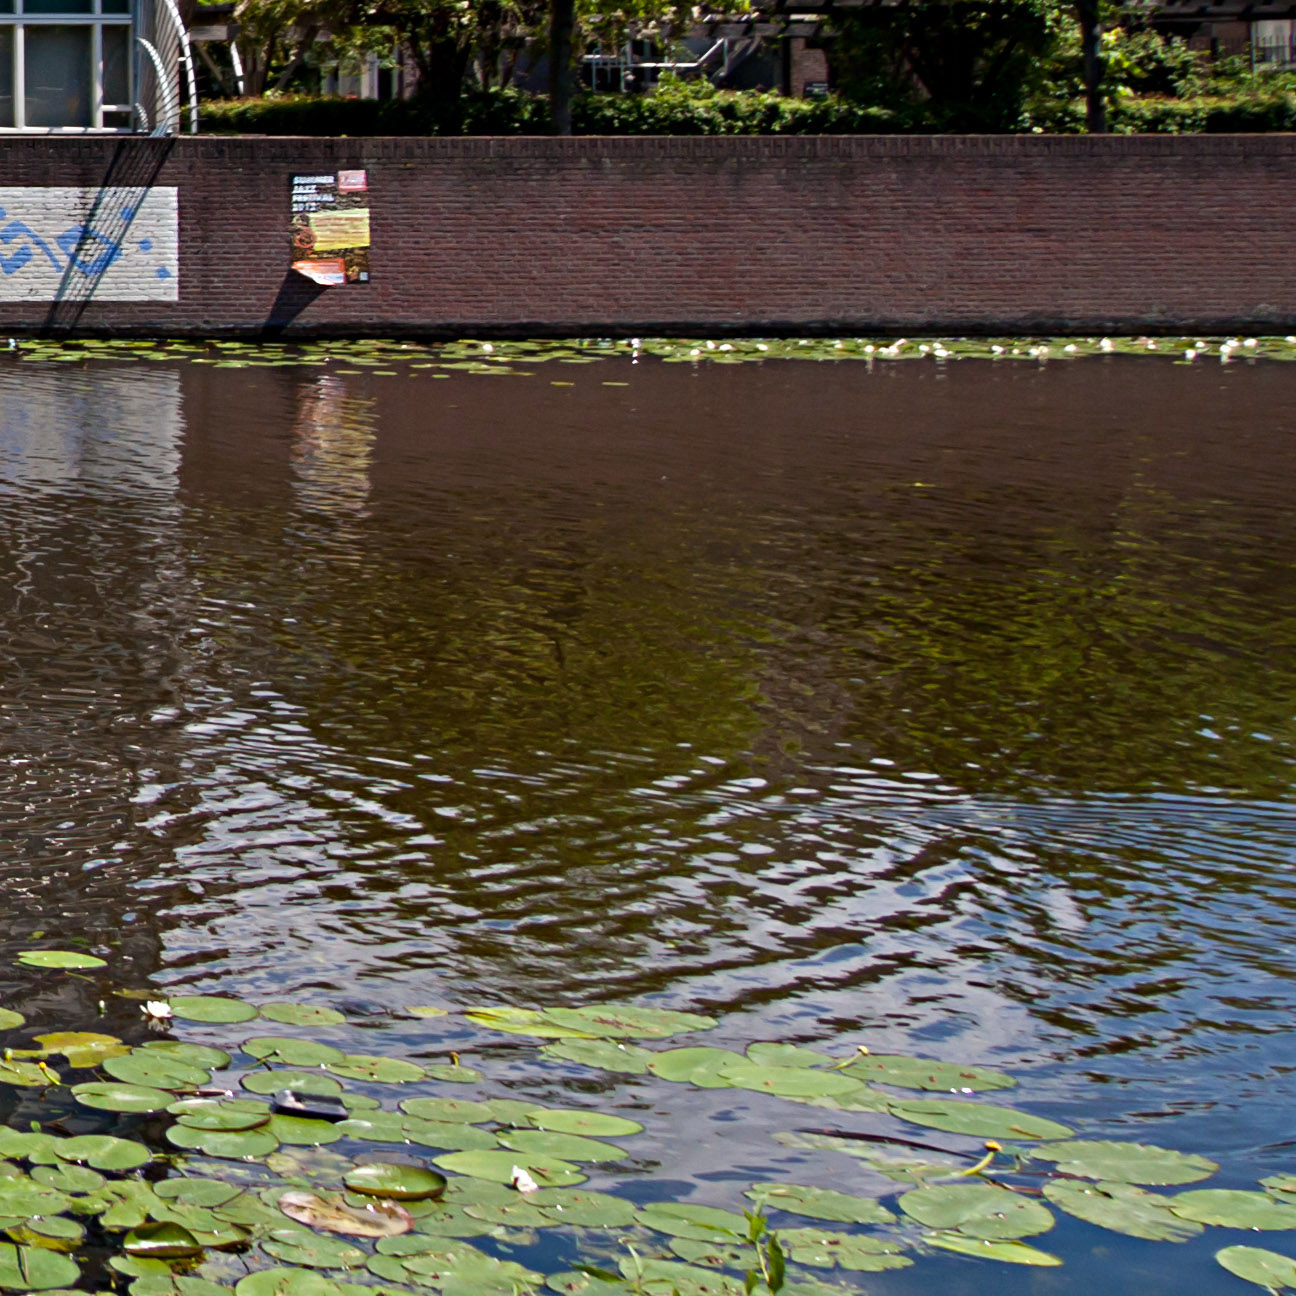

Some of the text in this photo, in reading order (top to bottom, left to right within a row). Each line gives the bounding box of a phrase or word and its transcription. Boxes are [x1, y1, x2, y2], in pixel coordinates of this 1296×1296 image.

[293, 176, 335, 184] SUMMER
[293, 185, 318, 194] JAZZ
[292, 194, 335, 202] FESTIVAL
